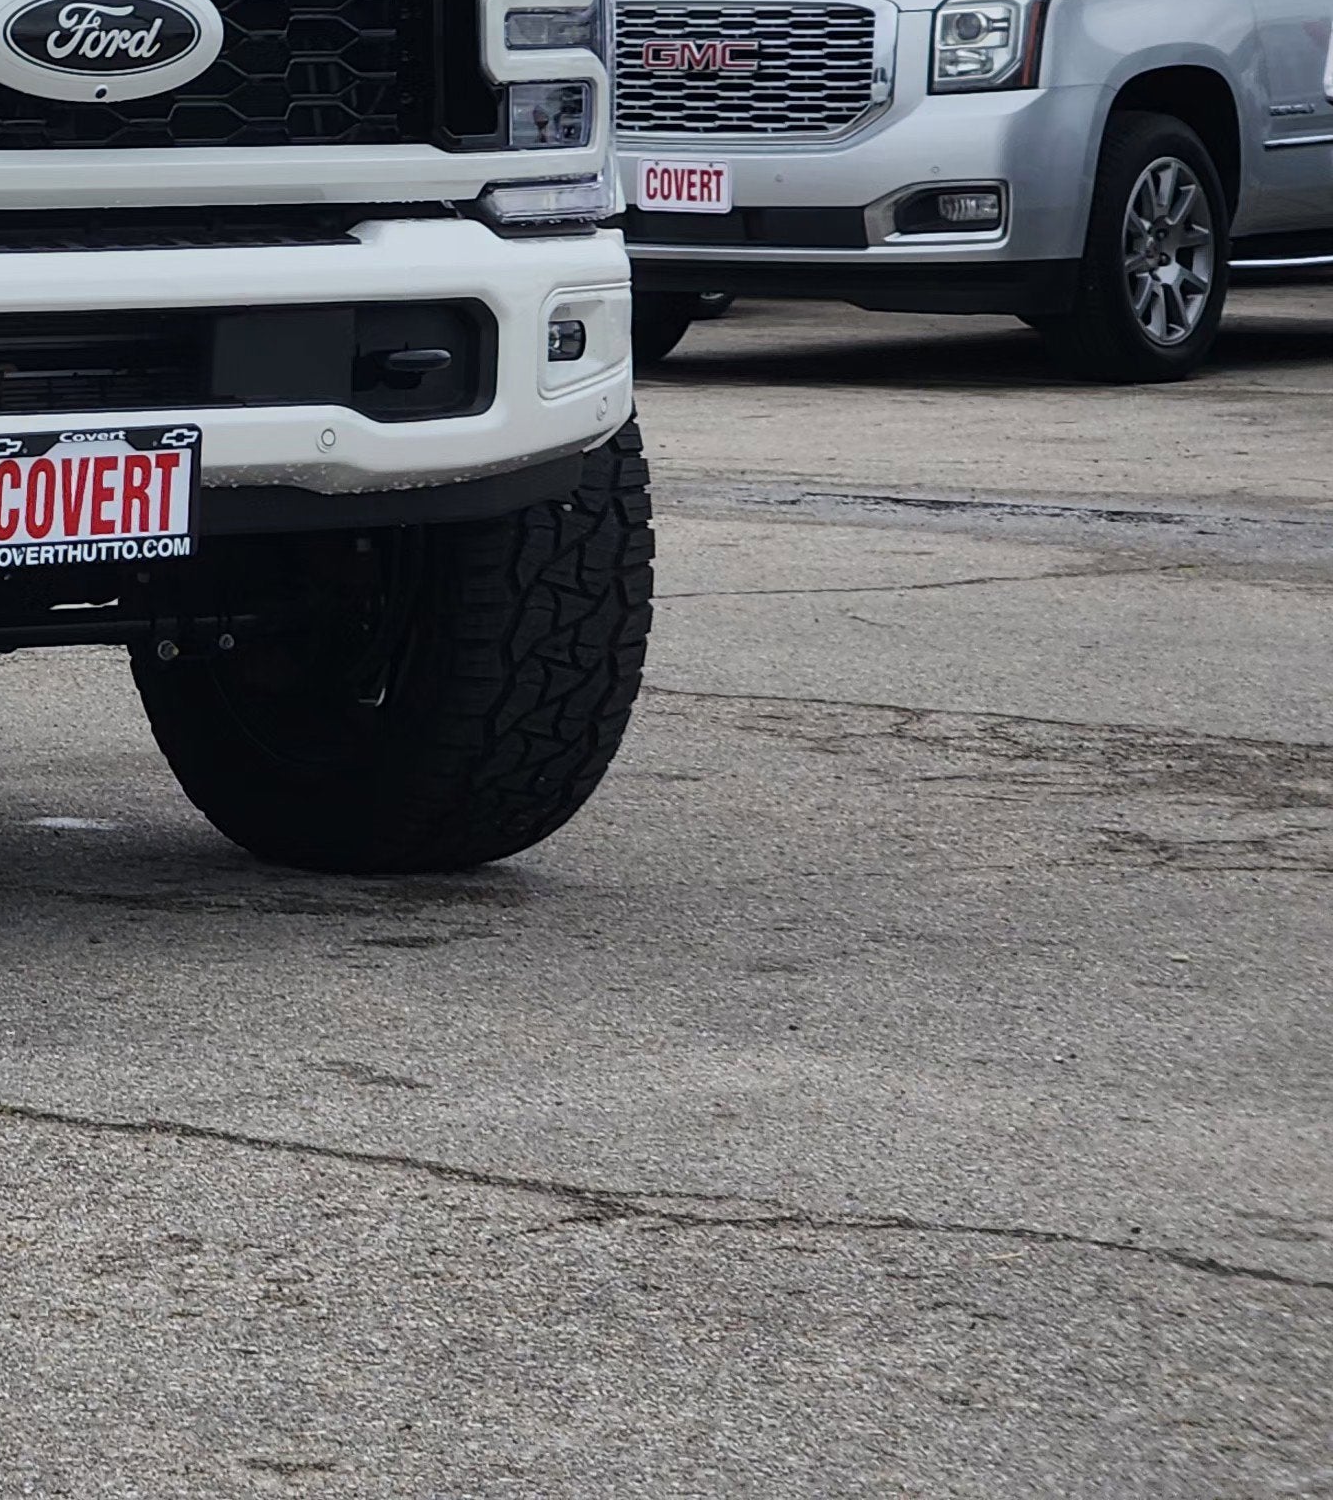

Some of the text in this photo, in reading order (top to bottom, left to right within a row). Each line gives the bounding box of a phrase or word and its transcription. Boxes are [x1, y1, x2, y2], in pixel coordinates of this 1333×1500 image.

[46, 2, 164, 60] Ford
[641, 40, 760, 71] GMC
[645, 167, 725, 203] COVERT
[59, 430, 126, 443] Covert
